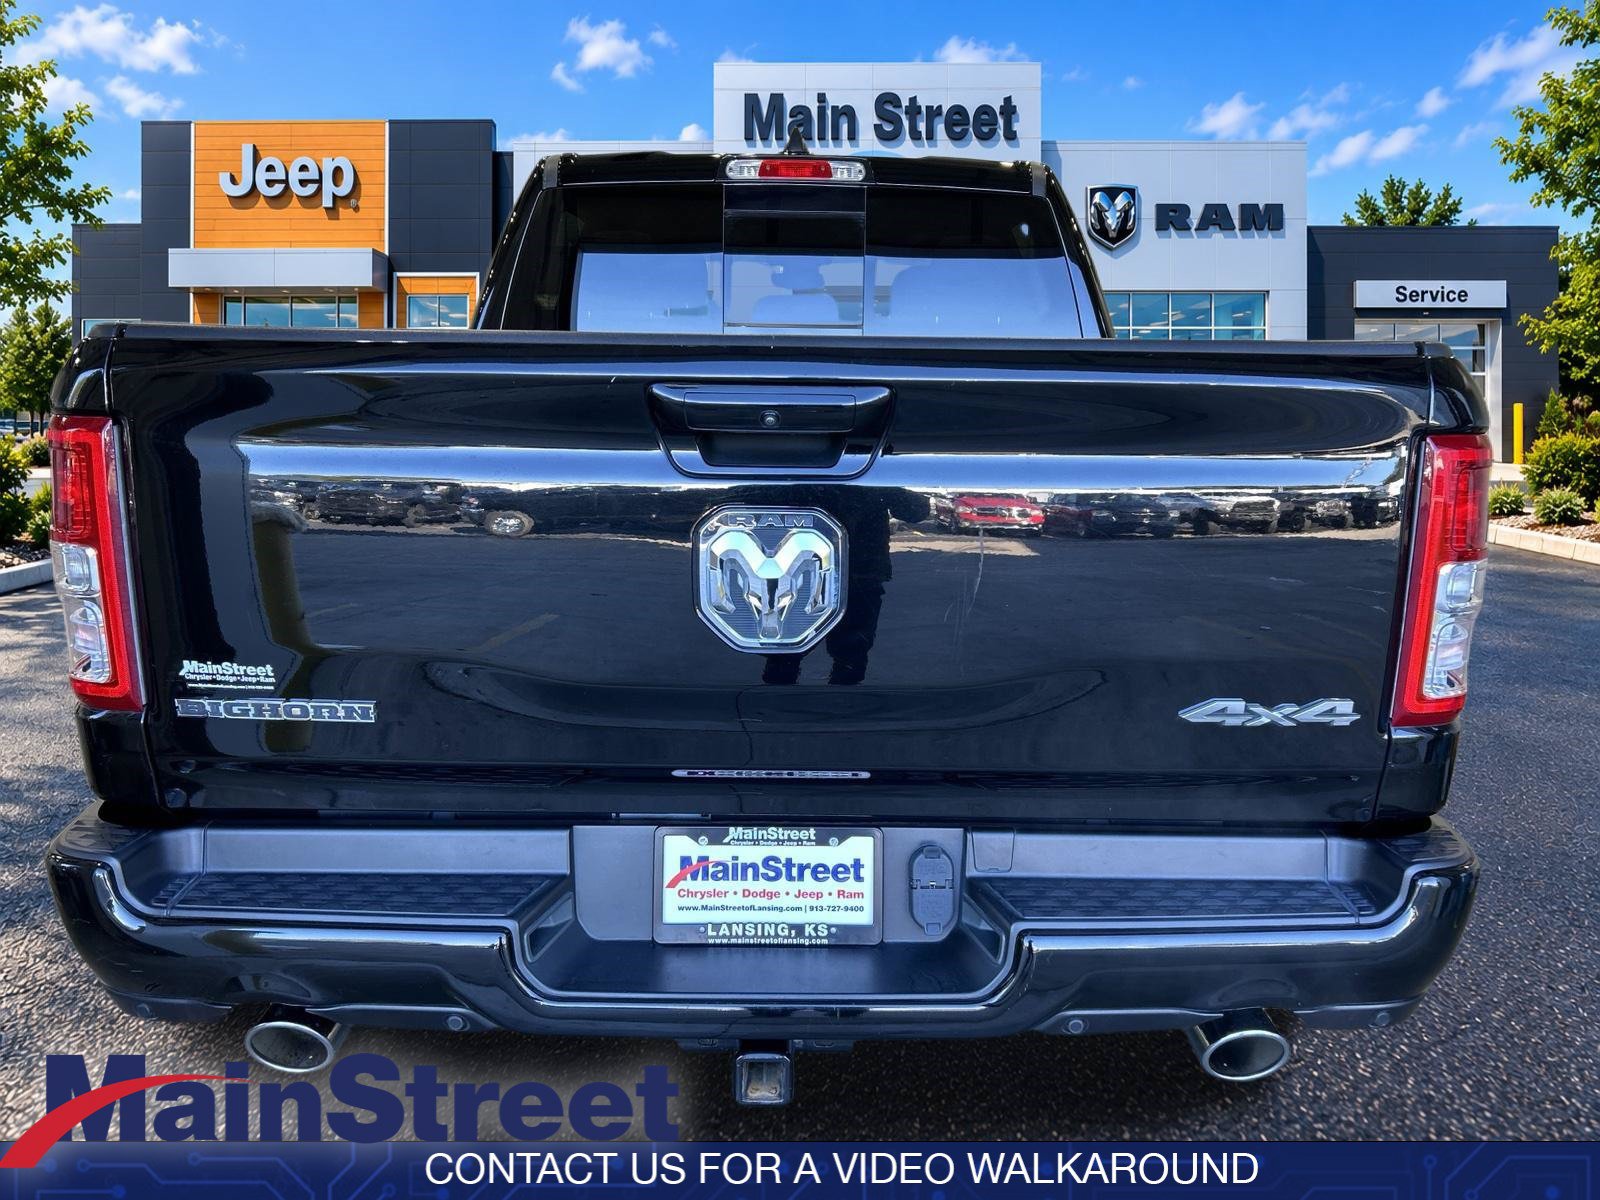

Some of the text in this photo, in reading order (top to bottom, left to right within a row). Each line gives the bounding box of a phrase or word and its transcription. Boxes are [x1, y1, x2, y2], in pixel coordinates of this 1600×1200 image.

[744, 91, 1017, 141] Main Street
[218, 143, 355, 208] Jeep
[1155, 203, 1284, 231] RAM
[1395, 285, 1469, 303] Service
[728, 514, 814, 527] RAM
[180, 660, 275, 676] MainStreet
[175, 698, 376, 723] BIGHORN
[1178, 698, 1361, 726] 4x4
[725, 827, 817, 842] MainStreet
[676, 855, 865, 883] MainStreet
[677, 888, 865, 901] Chrysler Dodge Jeep Ram
[677, 904, 865, 913] www.MainStreetofLansing.com 913-727-9400
[707, 923, 829, 938] LANSING, KS
